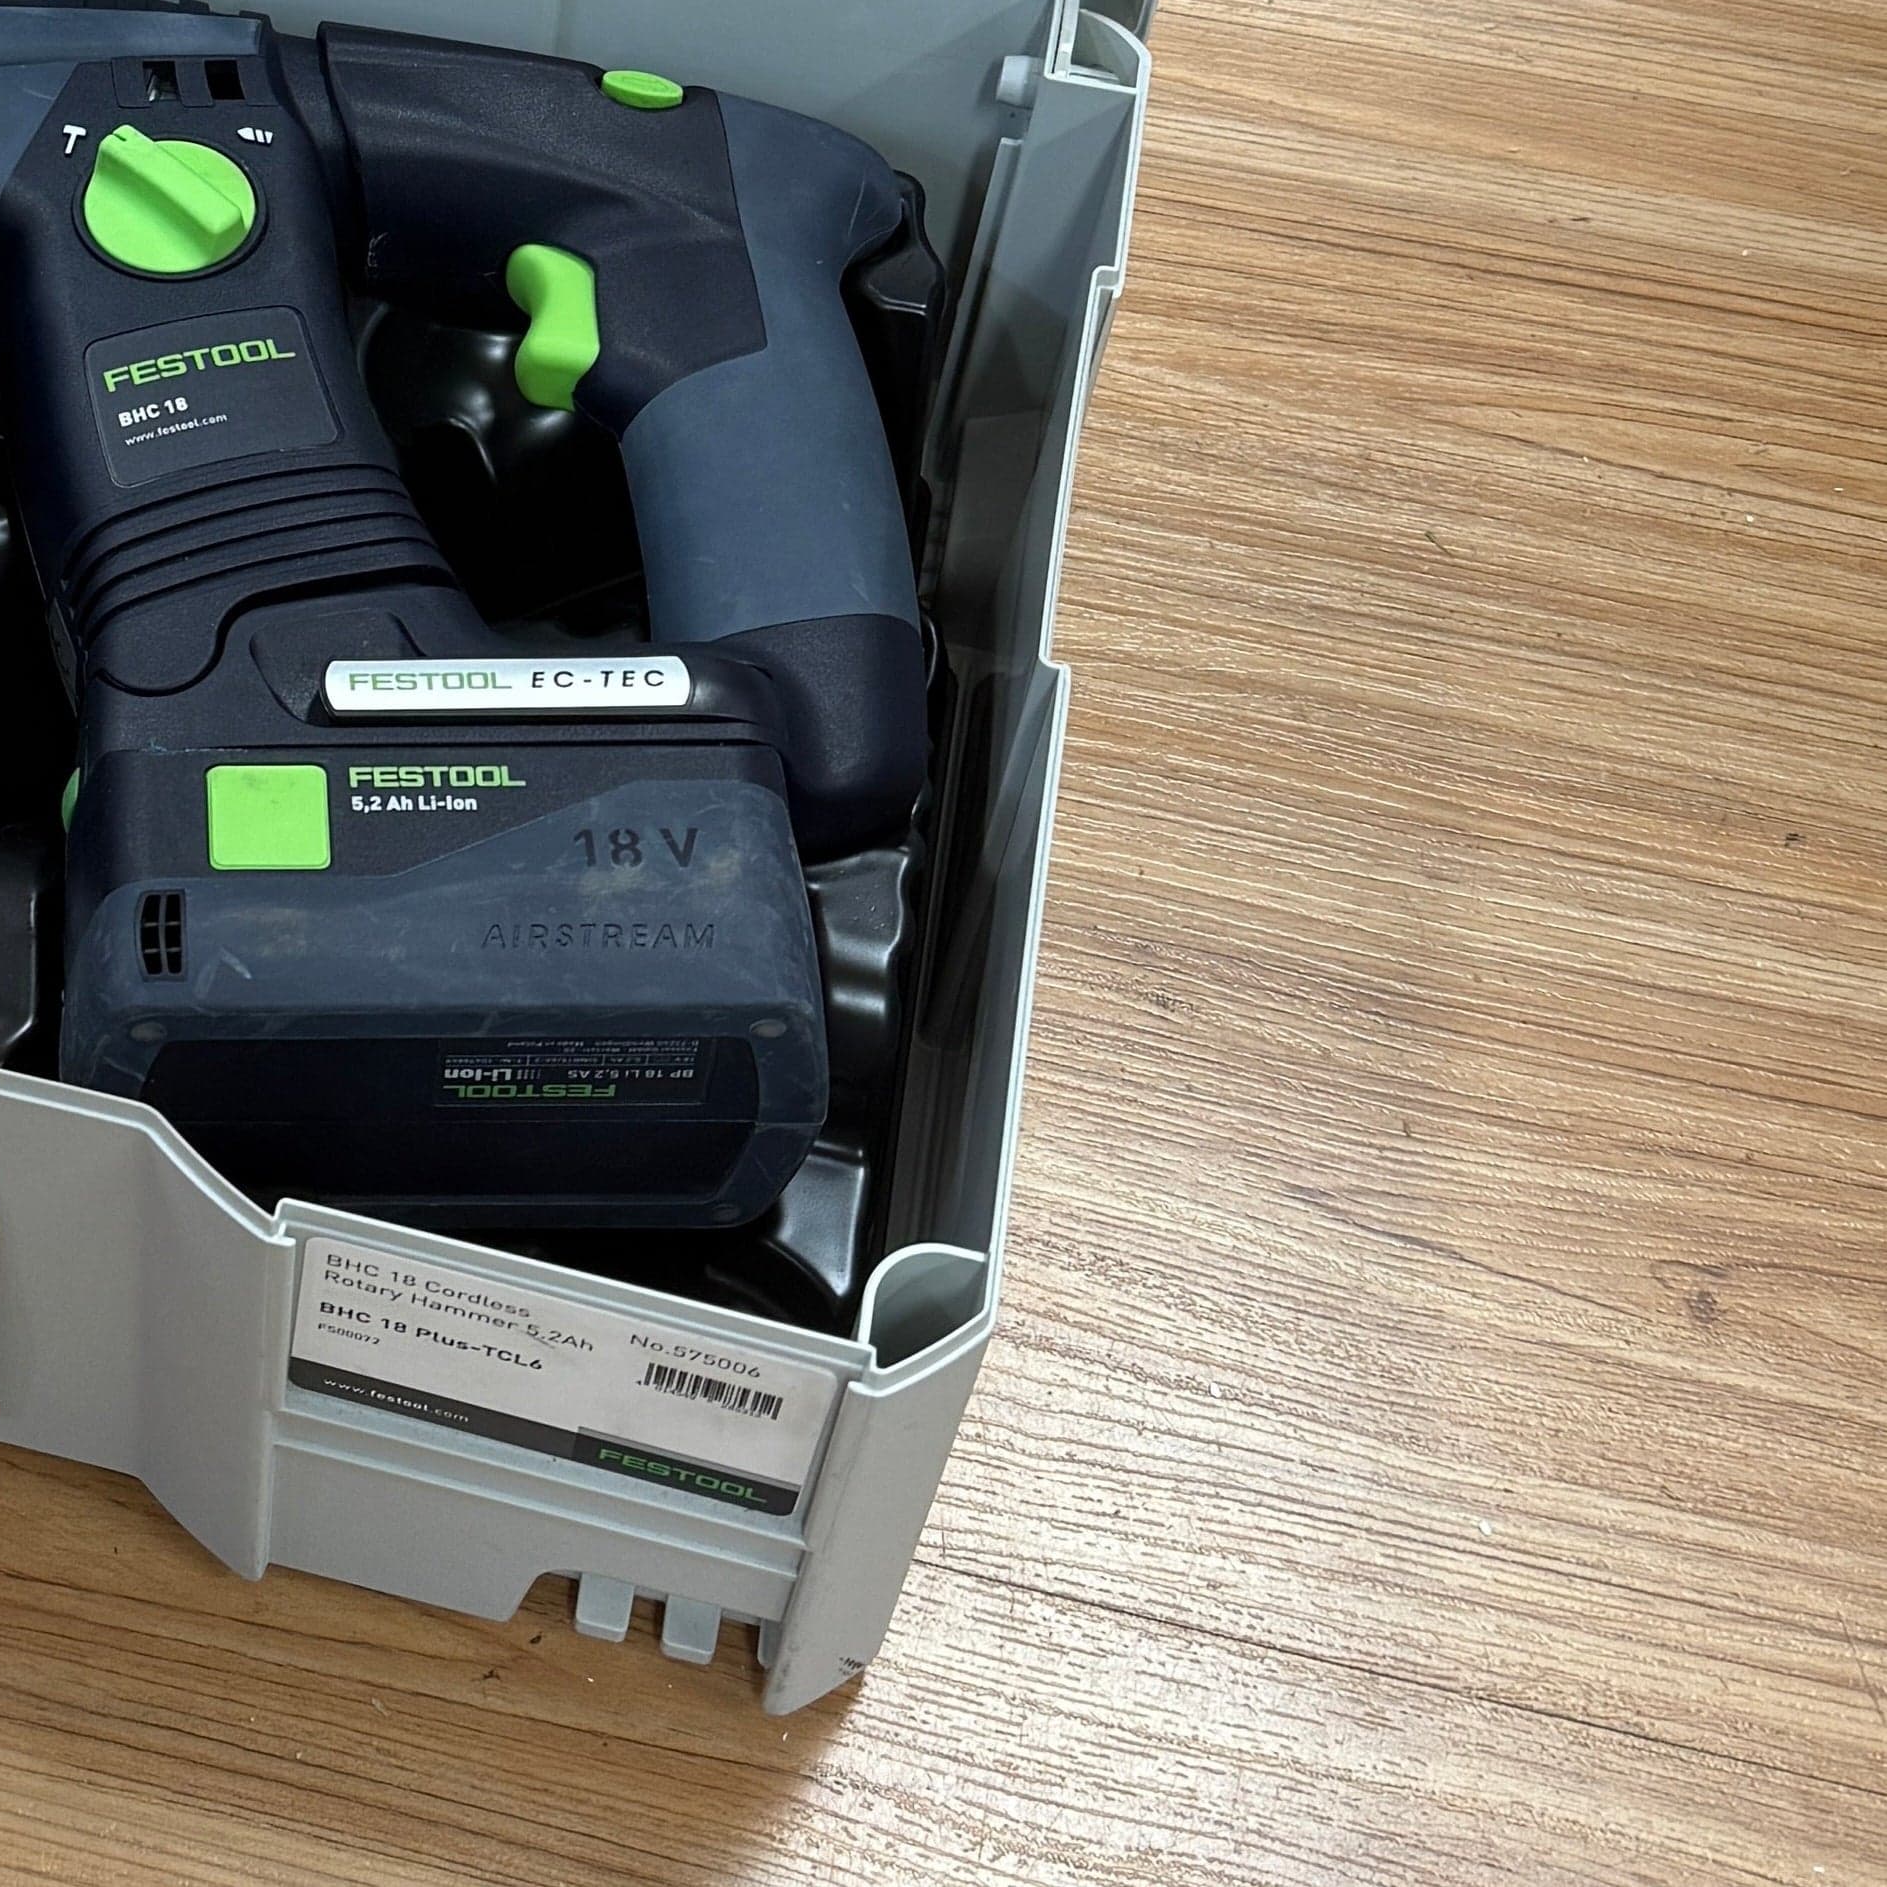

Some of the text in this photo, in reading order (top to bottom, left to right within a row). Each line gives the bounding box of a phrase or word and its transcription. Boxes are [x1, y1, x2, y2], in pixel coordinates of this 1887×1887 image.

[103, 338, 297, 393] FESTOOL
[118, 396, 189, 429] BHC 18
[124, 414, 229, 447] www.festool.com
[349, 669, 665, 691] FESTOOL EC-TEC
[348, 765, 527, 789] FESTOOL
[351, 795, 478, 814] 5,2 Ah Li-Ion
[573, 827, 699, 869] 18 V
[480, 923, 715, 950] AIRSTREAM
[443, 1068, 512, 1082] Li-Ion
[443, 1084, 617, 1099] FESTOOL
[324, 1269, 403, 1301] Rotary
[411, 1293, 519, 1331] Hammer
[327, 1253, 531, 1318] BHC 18 Cordless
[320, 1302, 543, 1371] BHC 18 Plus-TCL6
[630, 1334, 761, 1379] No.575006
[323, 1378, 470, 1424] www.festool.com
[599, 1448, 768, 1505] FESTOOL
